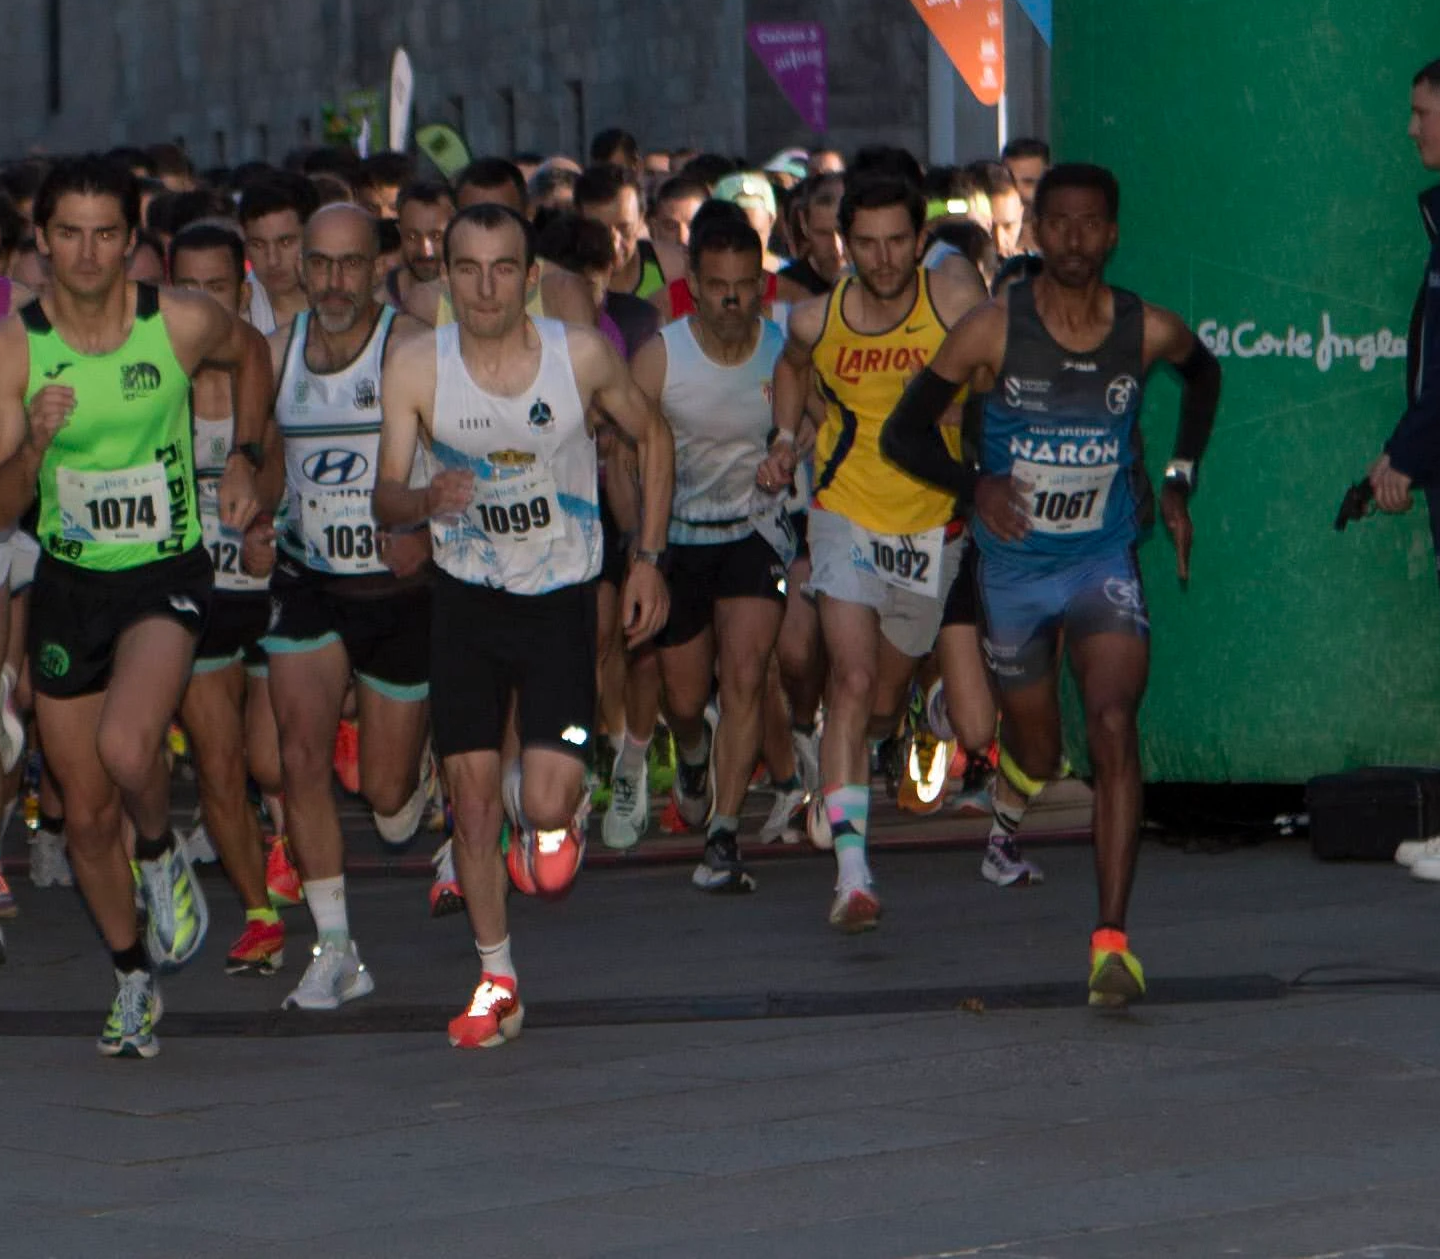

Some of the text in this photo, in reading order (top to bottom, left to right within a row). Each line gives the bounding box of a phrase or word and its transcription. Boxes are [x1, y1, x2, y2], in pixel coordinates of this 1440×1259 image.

[1197, 311, 1408, 372] El Corte Ingl
[834, 345, 929, 386] LARIOS
[1009, 435, 1120, 466] NARÓN
[85, 495, 157, 532] 1074
[476, 496, 552, 535] 1099
[322, 524, 385, 561] 103
[870, 540, 931, 584] 1092
